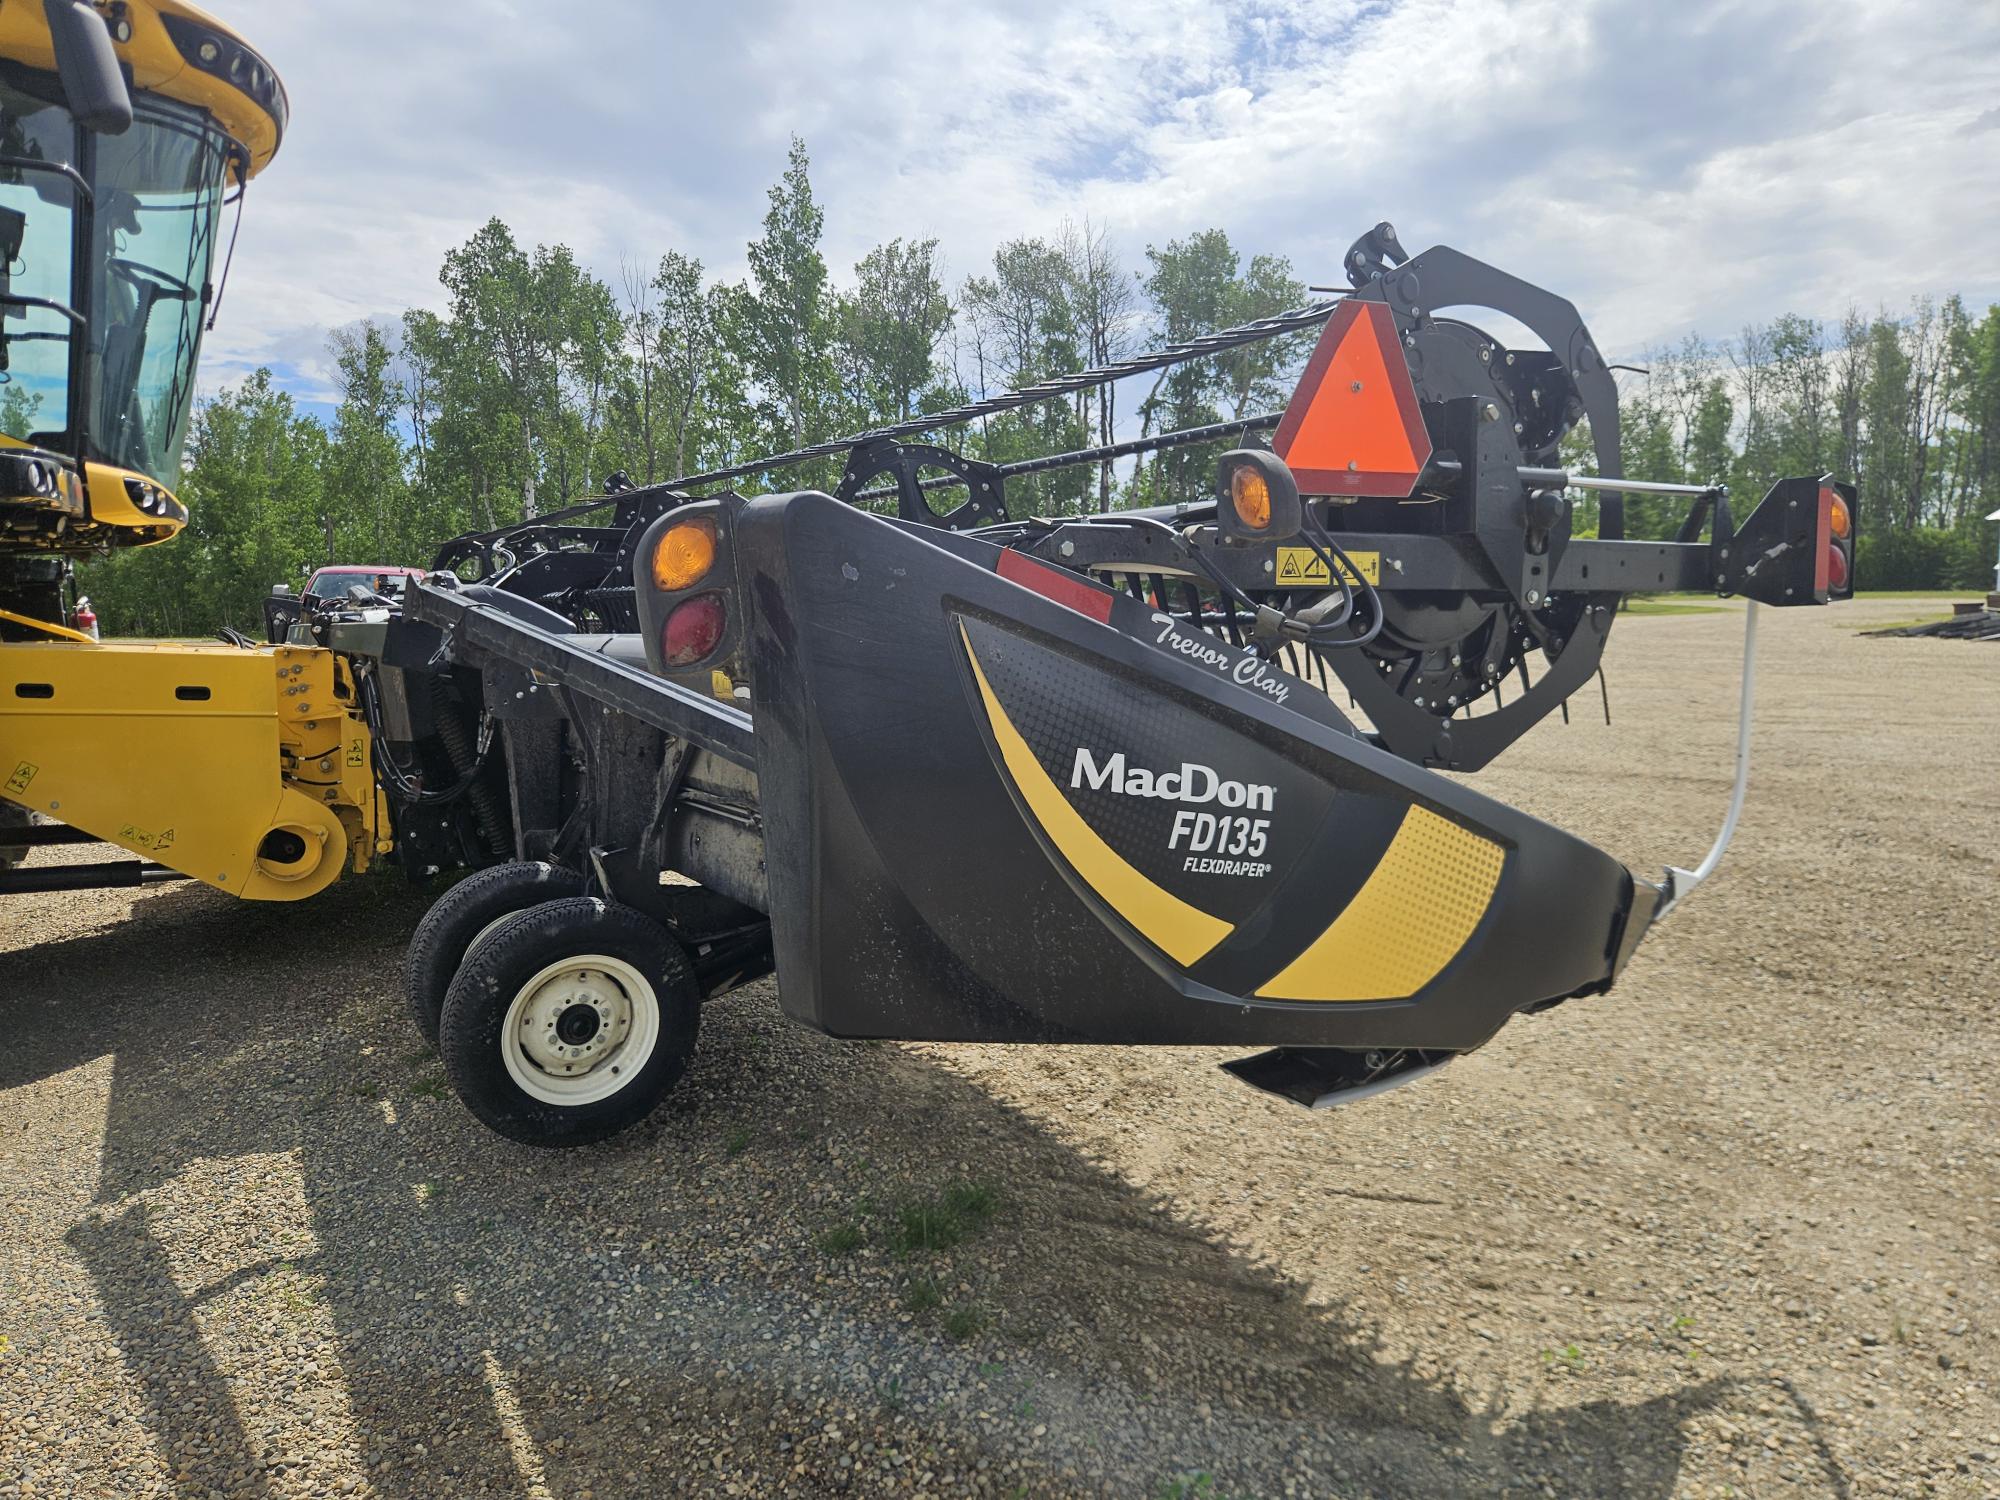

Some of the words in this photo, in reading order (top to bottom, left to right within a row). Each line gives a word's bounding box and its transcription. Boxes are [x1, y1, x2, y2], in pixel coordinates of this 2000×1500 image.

[1151, 612, 1229, 671] Trevor
[1232, 656, 1289, 704] Clay
[1070, 747, 1274, 812] MacDon
[1167, 810, 1271, 857] FD135
